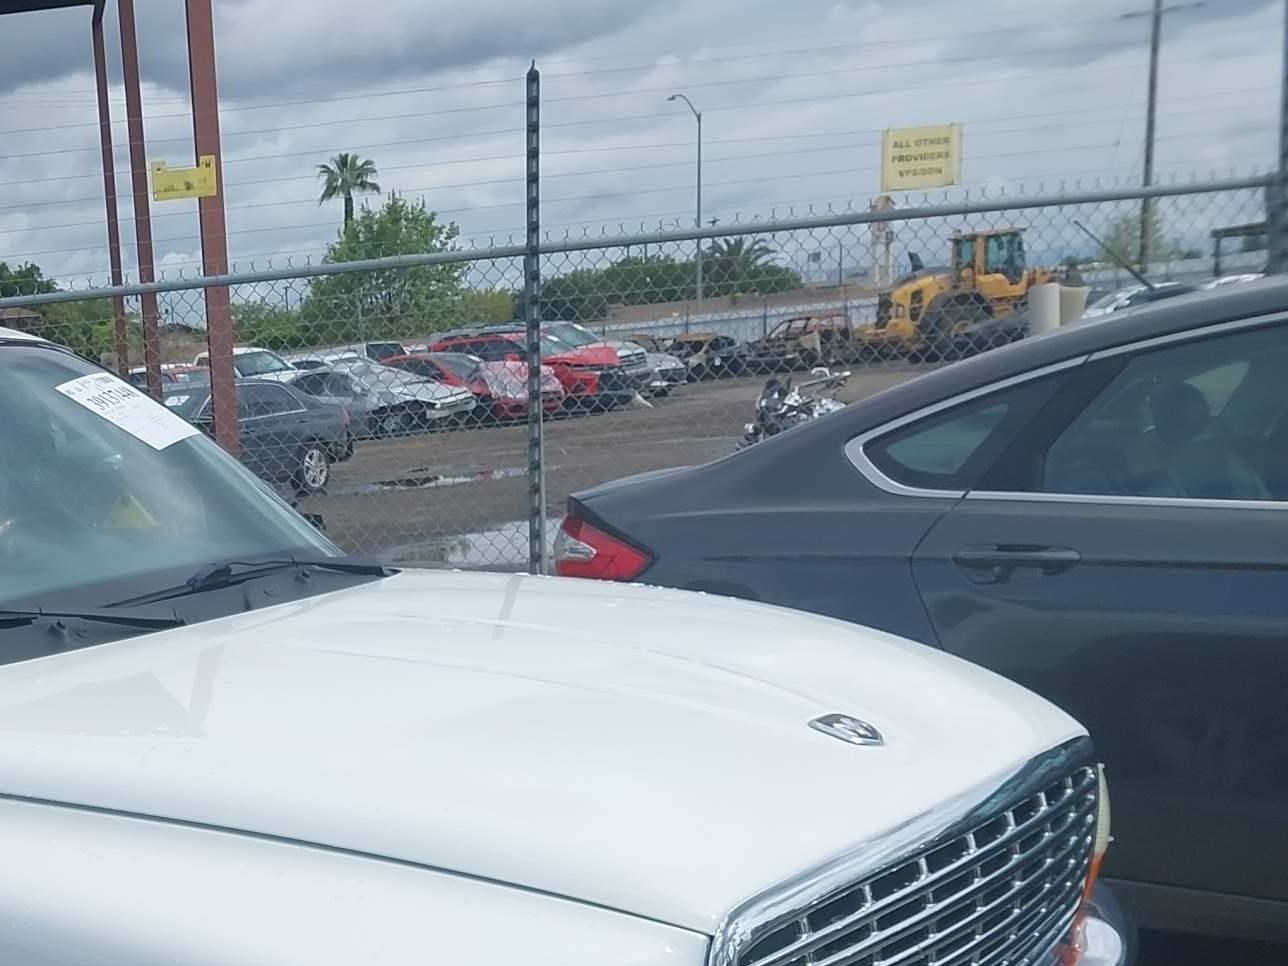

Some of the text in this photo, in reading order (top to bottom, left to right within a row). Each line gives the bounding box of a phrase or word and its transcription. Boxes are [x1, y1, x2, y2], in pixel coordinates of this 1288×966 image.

[892, 137, 950, 149] ALL OTHER
[891, 151, 950, 163] PROVIDERS
